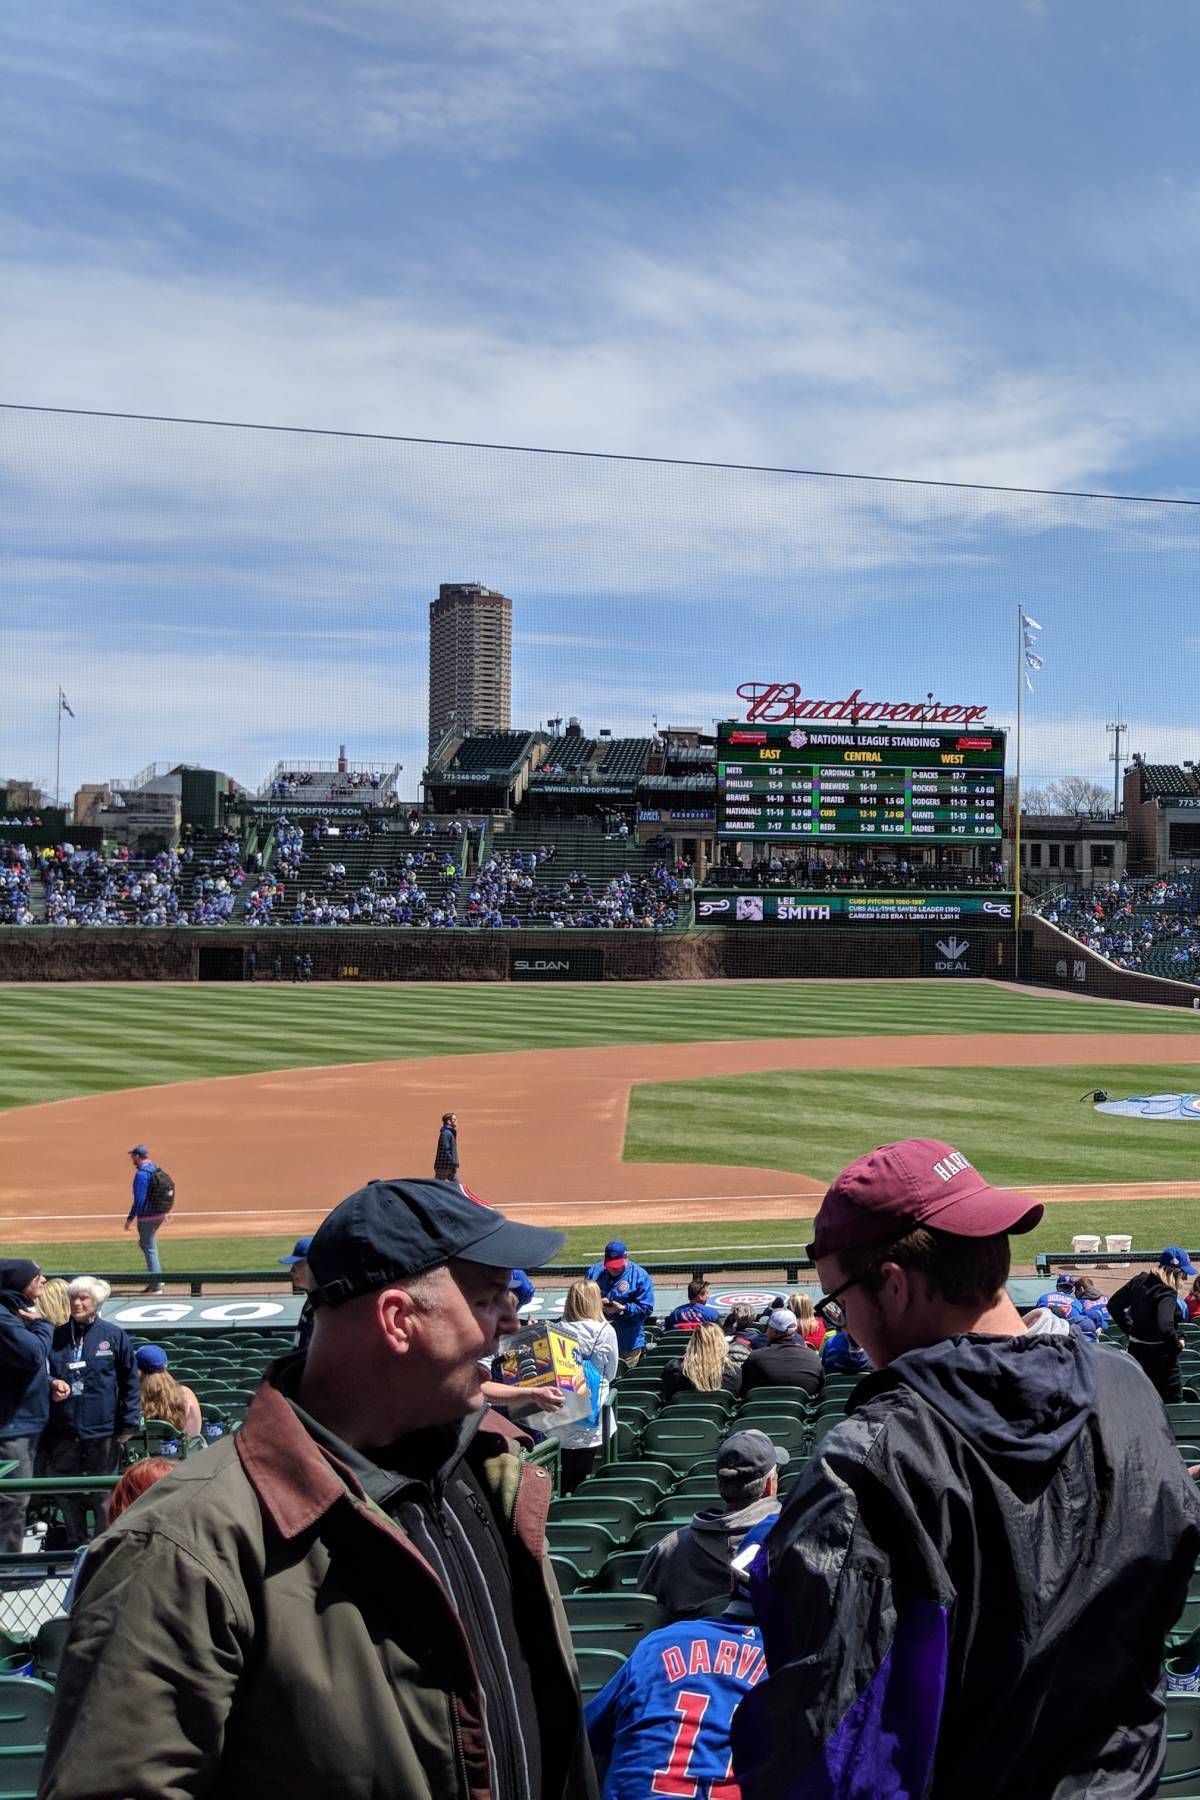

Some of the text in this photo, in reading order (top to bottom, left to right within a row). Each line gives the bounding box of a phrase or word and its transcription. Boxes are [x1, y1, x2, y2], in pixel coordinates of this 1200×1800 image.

[736, 682, 988, 723] Budweiser
[810, 734, 940, 748] NATIONAL LEAGUE STANDINGS
[760, 749, 781, 760] EAST
[844, 751, 882, 762] CENTRAL
[941, 754, 964, 764] WEST
[726, 780, 753, 788] PHILLIES
[986, 786, 994, 794] GB
[792, 795, 801, 803] 1.5
[803, 795, 812, 803] GB
[885, 797, 894, 805] 1.5
[895, 797, 904, 805] GB
[950, 799, 967, 807] 11-12
[975, 799, 985, 807] 5.5
[253, 806, 361, 816] WRIGLEYROOFTOPS.COM
[791, 809, 801, 817] 5.0
[803, 809, 812, 817] GB
[820, 809, 836, 817] CUBS
[895, 810, 904, 818] GB
[950, 812, 967, 820] 11-13
[986, 812, 994, 820] GB
[860, 824, 875, 832] 5-20
[881, 824, 894, 832] 10.5
[895, 824, 904, 832] GB
[912, 825, 935, 833] PADRES
[986, 826, 994, 834] GB
[777, 897, 795, 905] LEE
[777, 906, 830, 920] SMITH
[514, 960, 569, 970] SLOAN
[935, 962, 970, 971] IDEAL
[115, 1302, 284, 1322] GO
